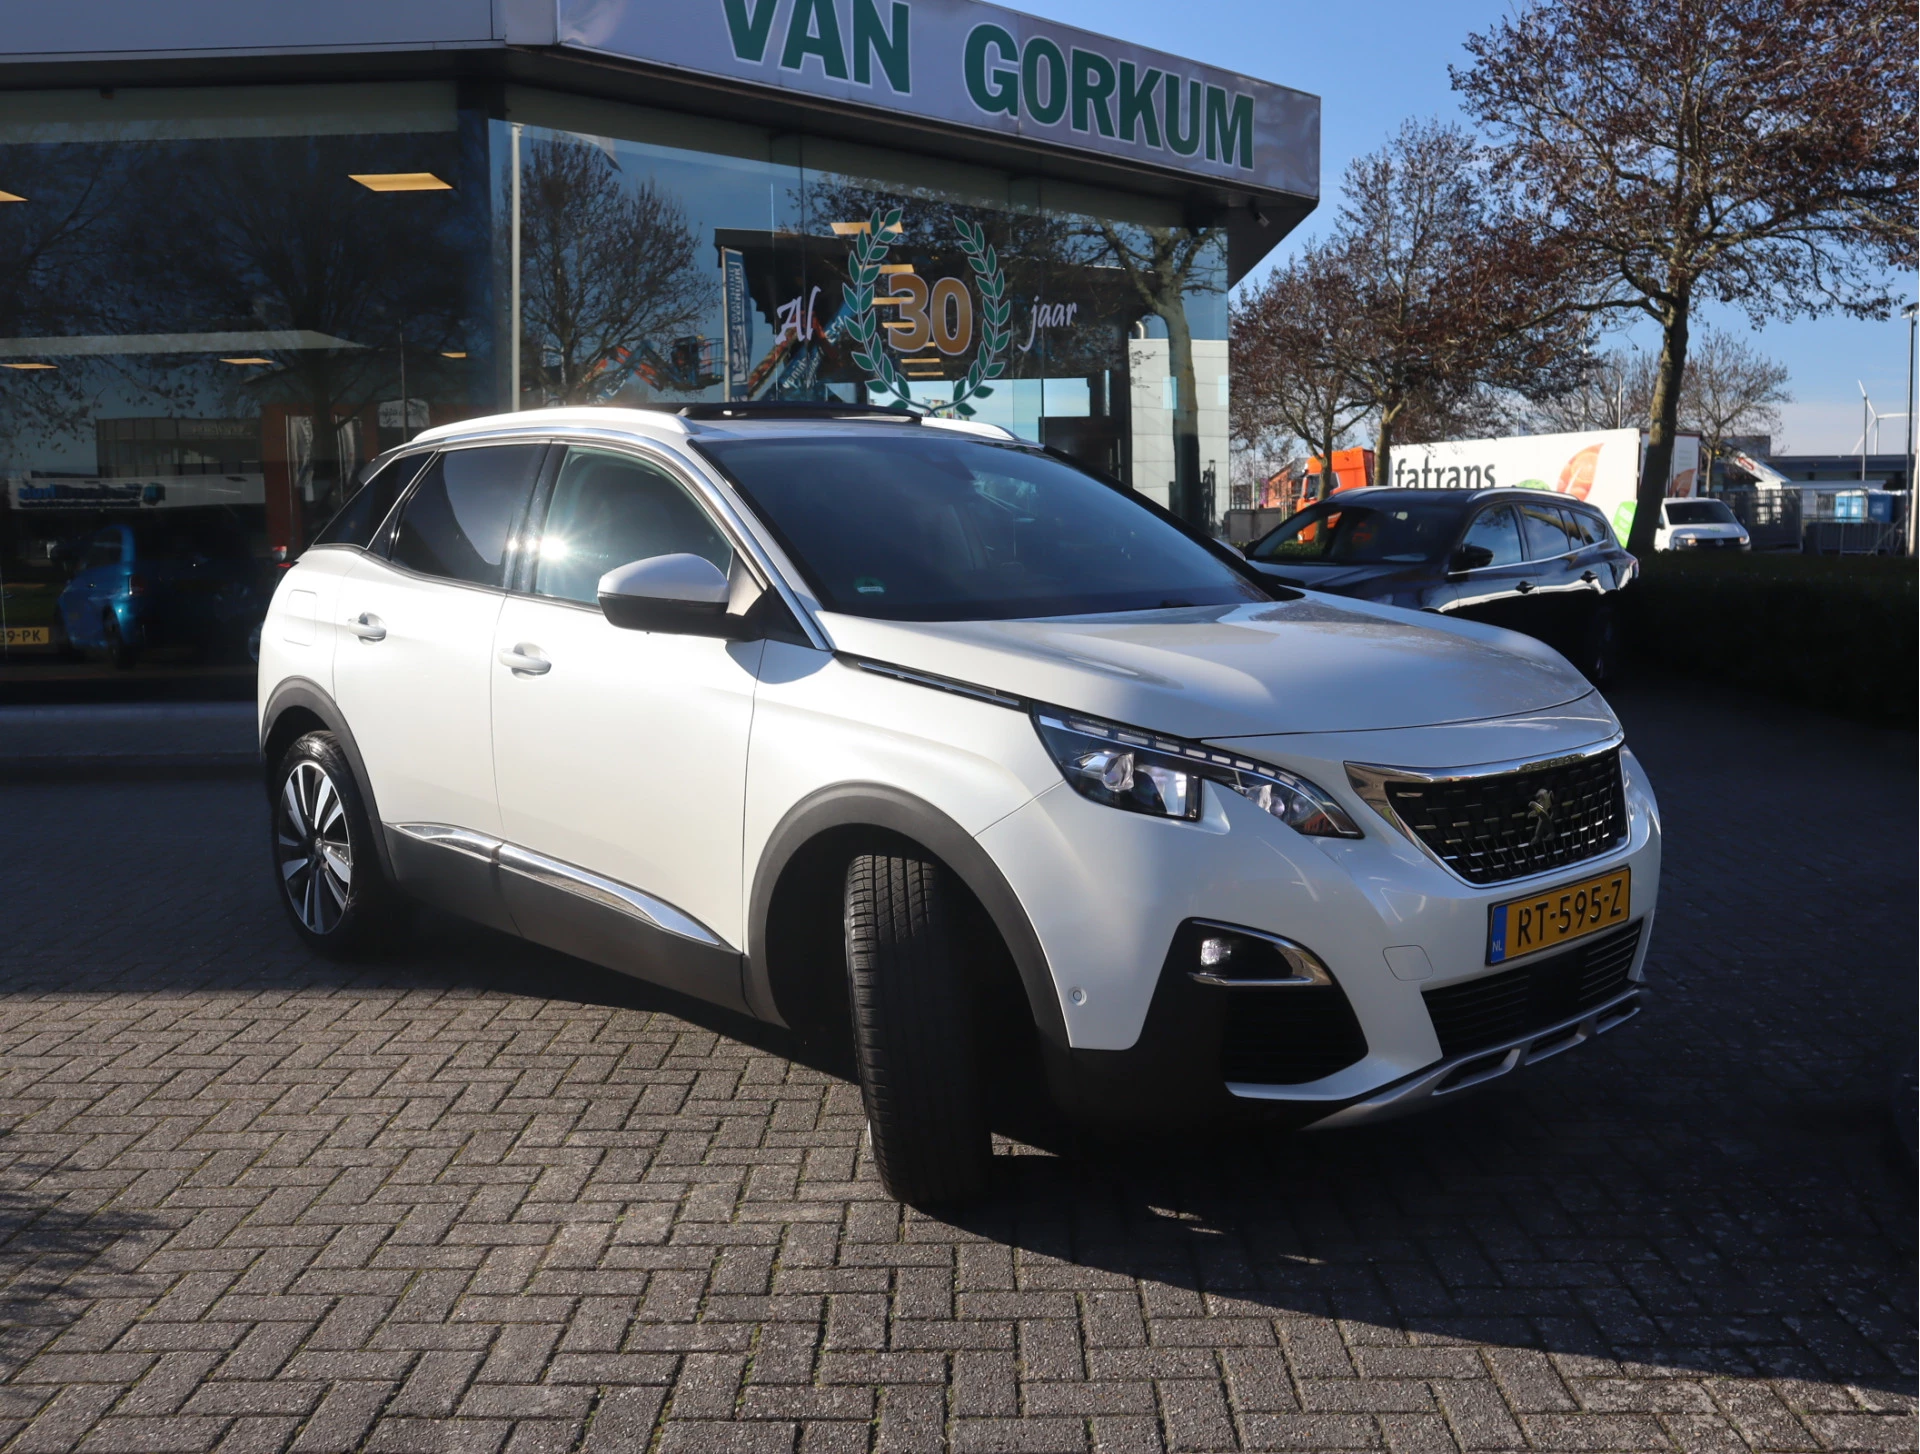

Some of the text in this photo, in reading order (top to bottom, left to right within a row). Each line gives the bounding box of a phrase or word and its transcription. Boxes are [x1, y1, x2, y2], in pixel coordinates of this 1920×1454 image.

[721, 0, 1255, 170] VAN GORKUM
[775, 286, 821, 345] Al
[888, 273, 973, 356] 30
[1017, 296, 1078, 352] jaar
[1395, 456, 1496, 488] fatrans
[1492, 939, 1503, 952] NL
[1517, 879, 1622, 948] RT-595-Z
